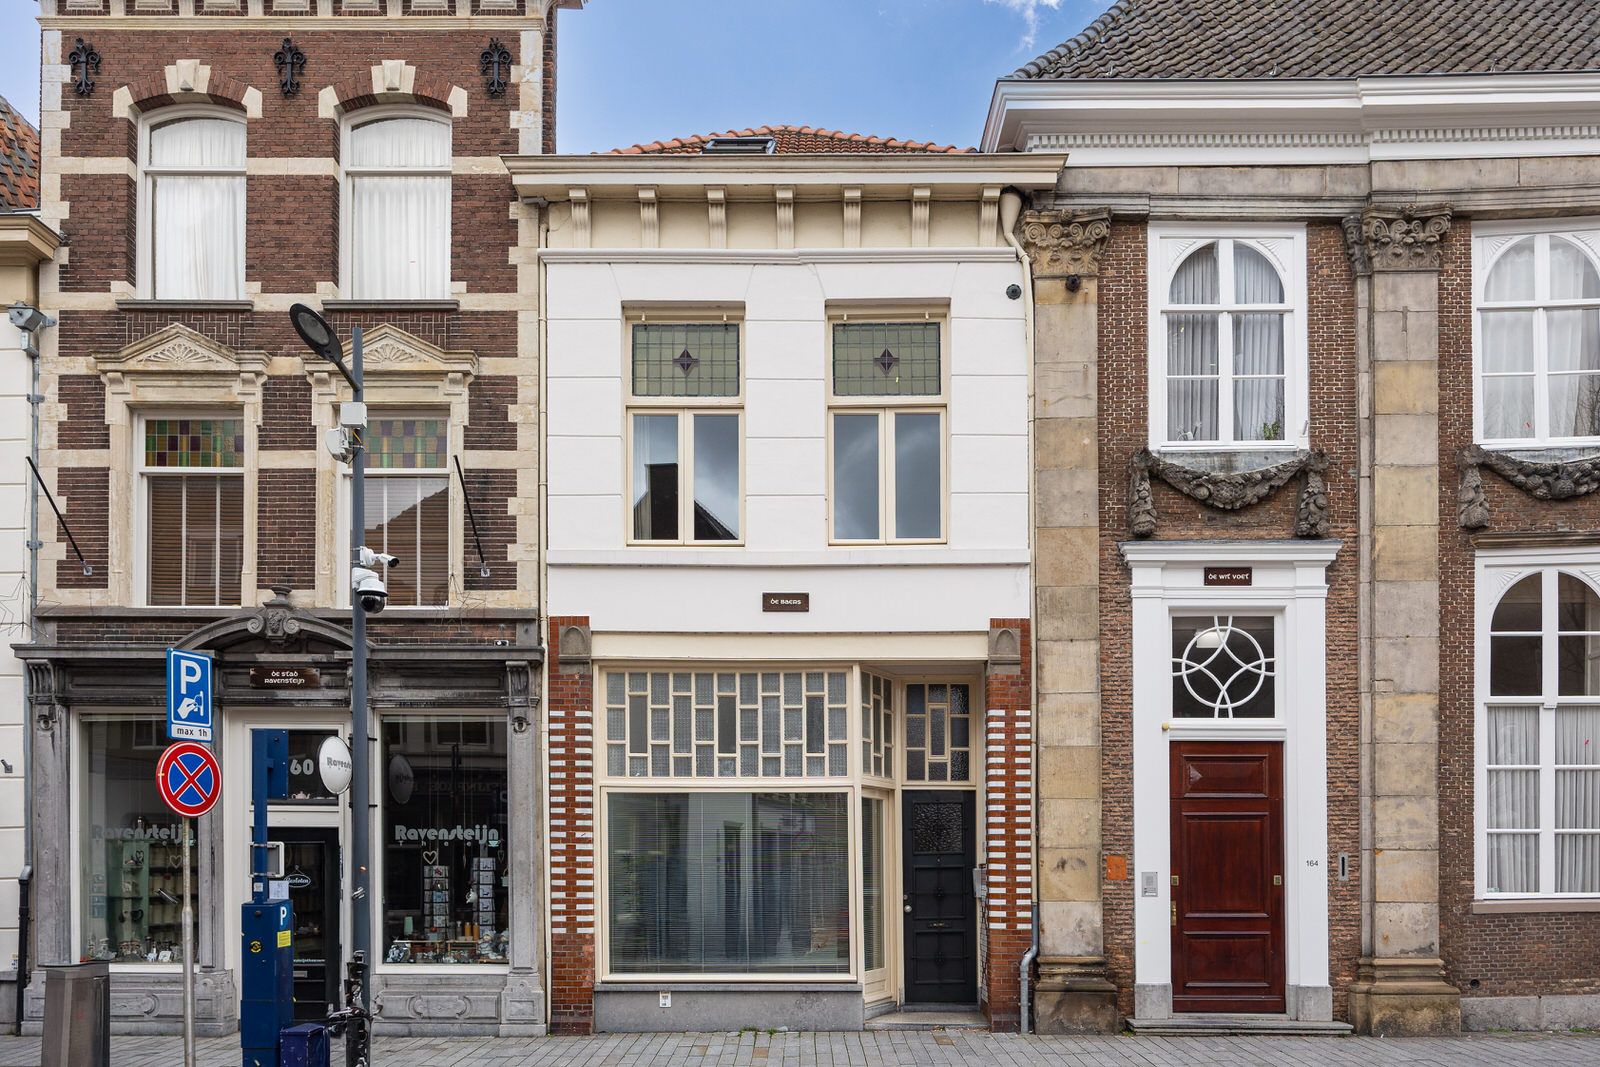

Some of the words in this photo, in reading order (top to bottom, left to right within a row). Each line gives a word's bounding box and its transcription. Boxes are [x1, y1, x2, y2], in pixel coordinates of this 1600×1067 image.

[180, 659, 202, 694] P
[176, 726, 194, 736] max
[198, 726, 208, 737] 1h
[289, 758, 314, 775] 60
[394, 824, 499, 844] Ravensteijn
[279, 906, 287, 926] P
